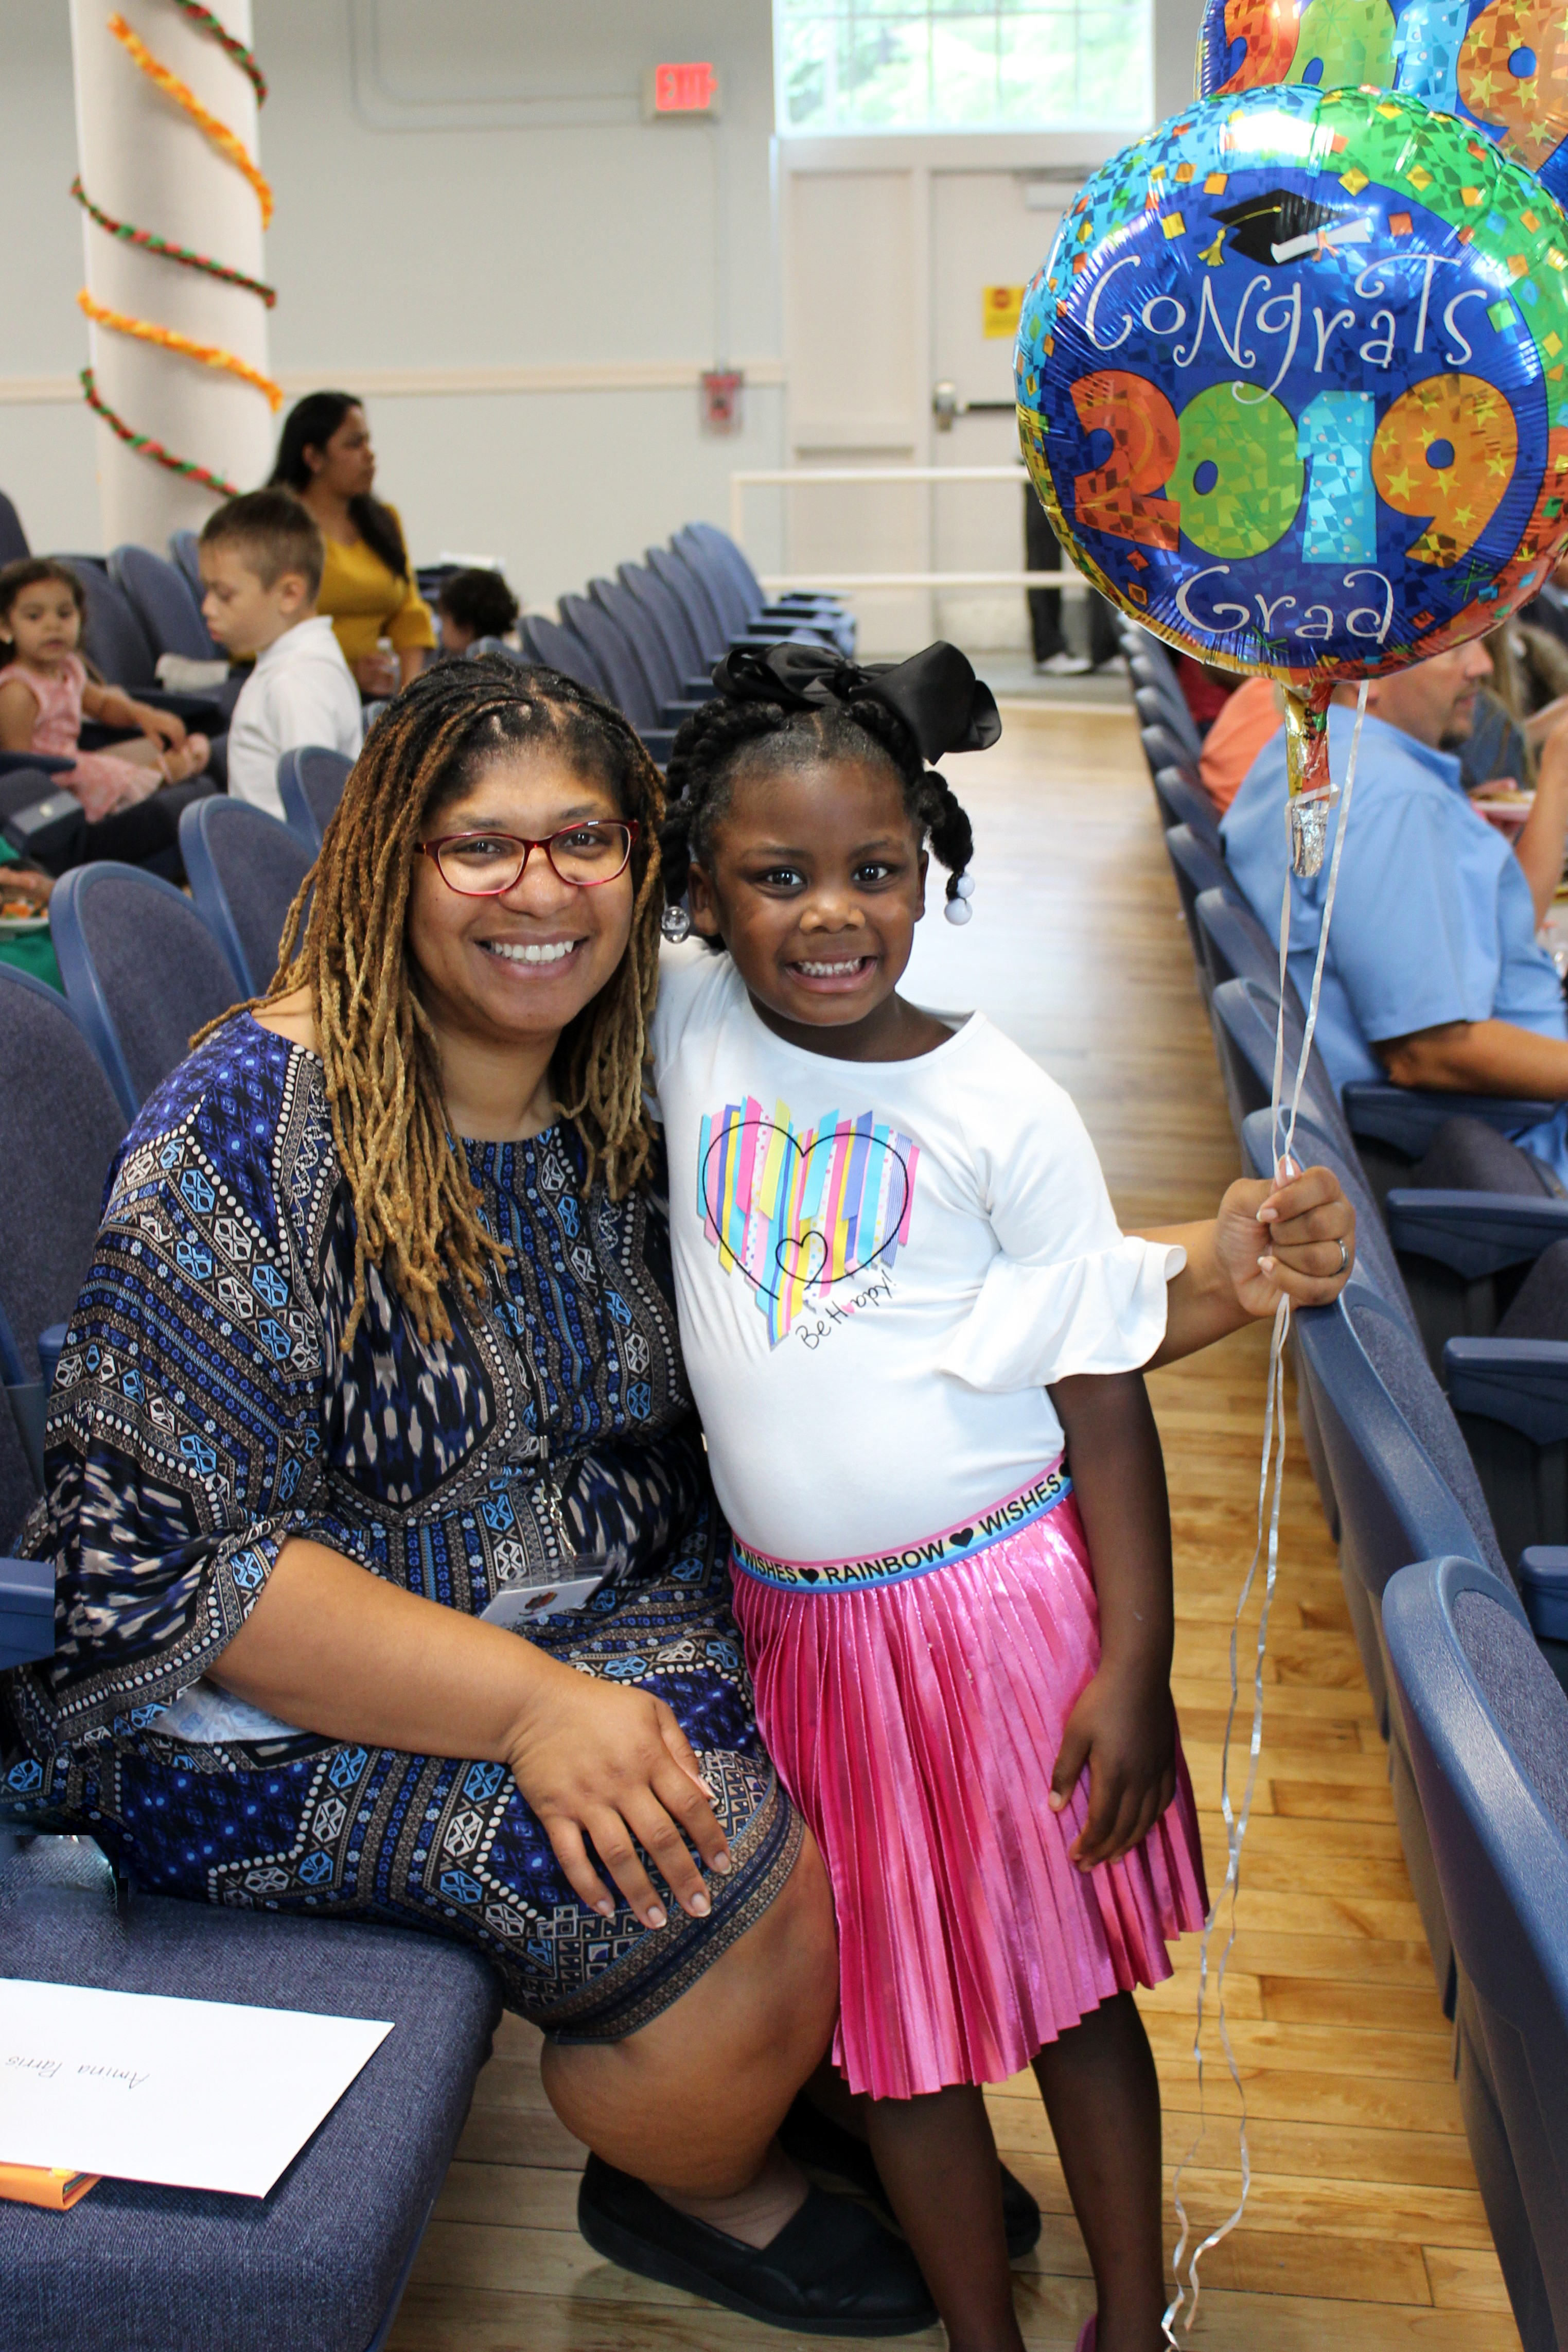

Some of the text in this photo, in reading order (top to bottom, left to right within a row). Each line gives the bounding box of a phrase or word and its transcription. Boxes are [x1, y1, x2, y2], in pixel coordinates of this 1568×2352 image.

[1069, 369, 1519, 568] 2019
[1175, 565, 1394, 644] Grad
[796, 1320, 831, 1350] Be
[744, 1473, 1061, 1585] WISHES RAINBOW WISHES
[77, 2064, 151, 2091] Amina
